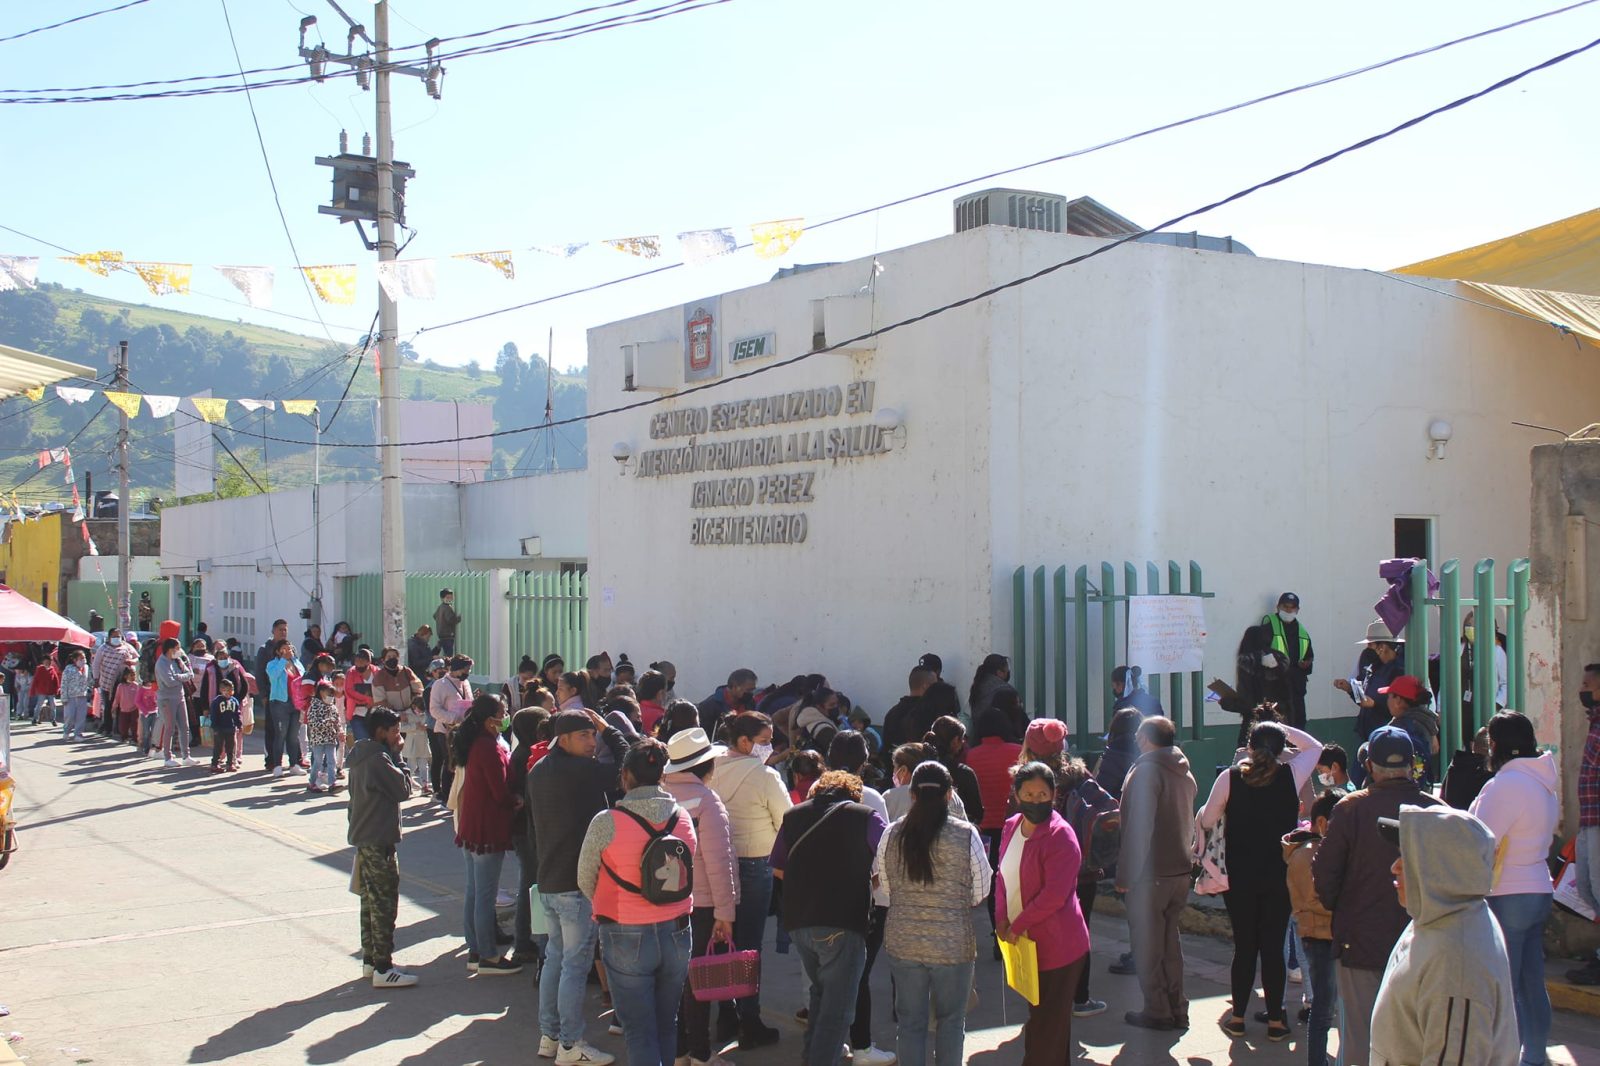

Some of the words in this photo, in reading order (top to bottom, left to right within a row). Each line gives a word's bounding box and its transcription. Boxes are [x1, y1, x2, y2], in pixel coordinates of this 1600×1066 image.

[733, 337, 766, 360] ISEM
[650, 407, 708, 439] CENTRO
[709, 385, 842, 433] ESPECIALIZADO
[845, 381, 875, 414] EN
[637, 436, 704, 477] ATENCIÓN
[704, 435, 782, 471] PRIMARIA
[690, 478, 754, 508] IGNACIO
[755, 472, 815, 504] PEREZ
[690, 513, 808, 545] BICENTENARIO
